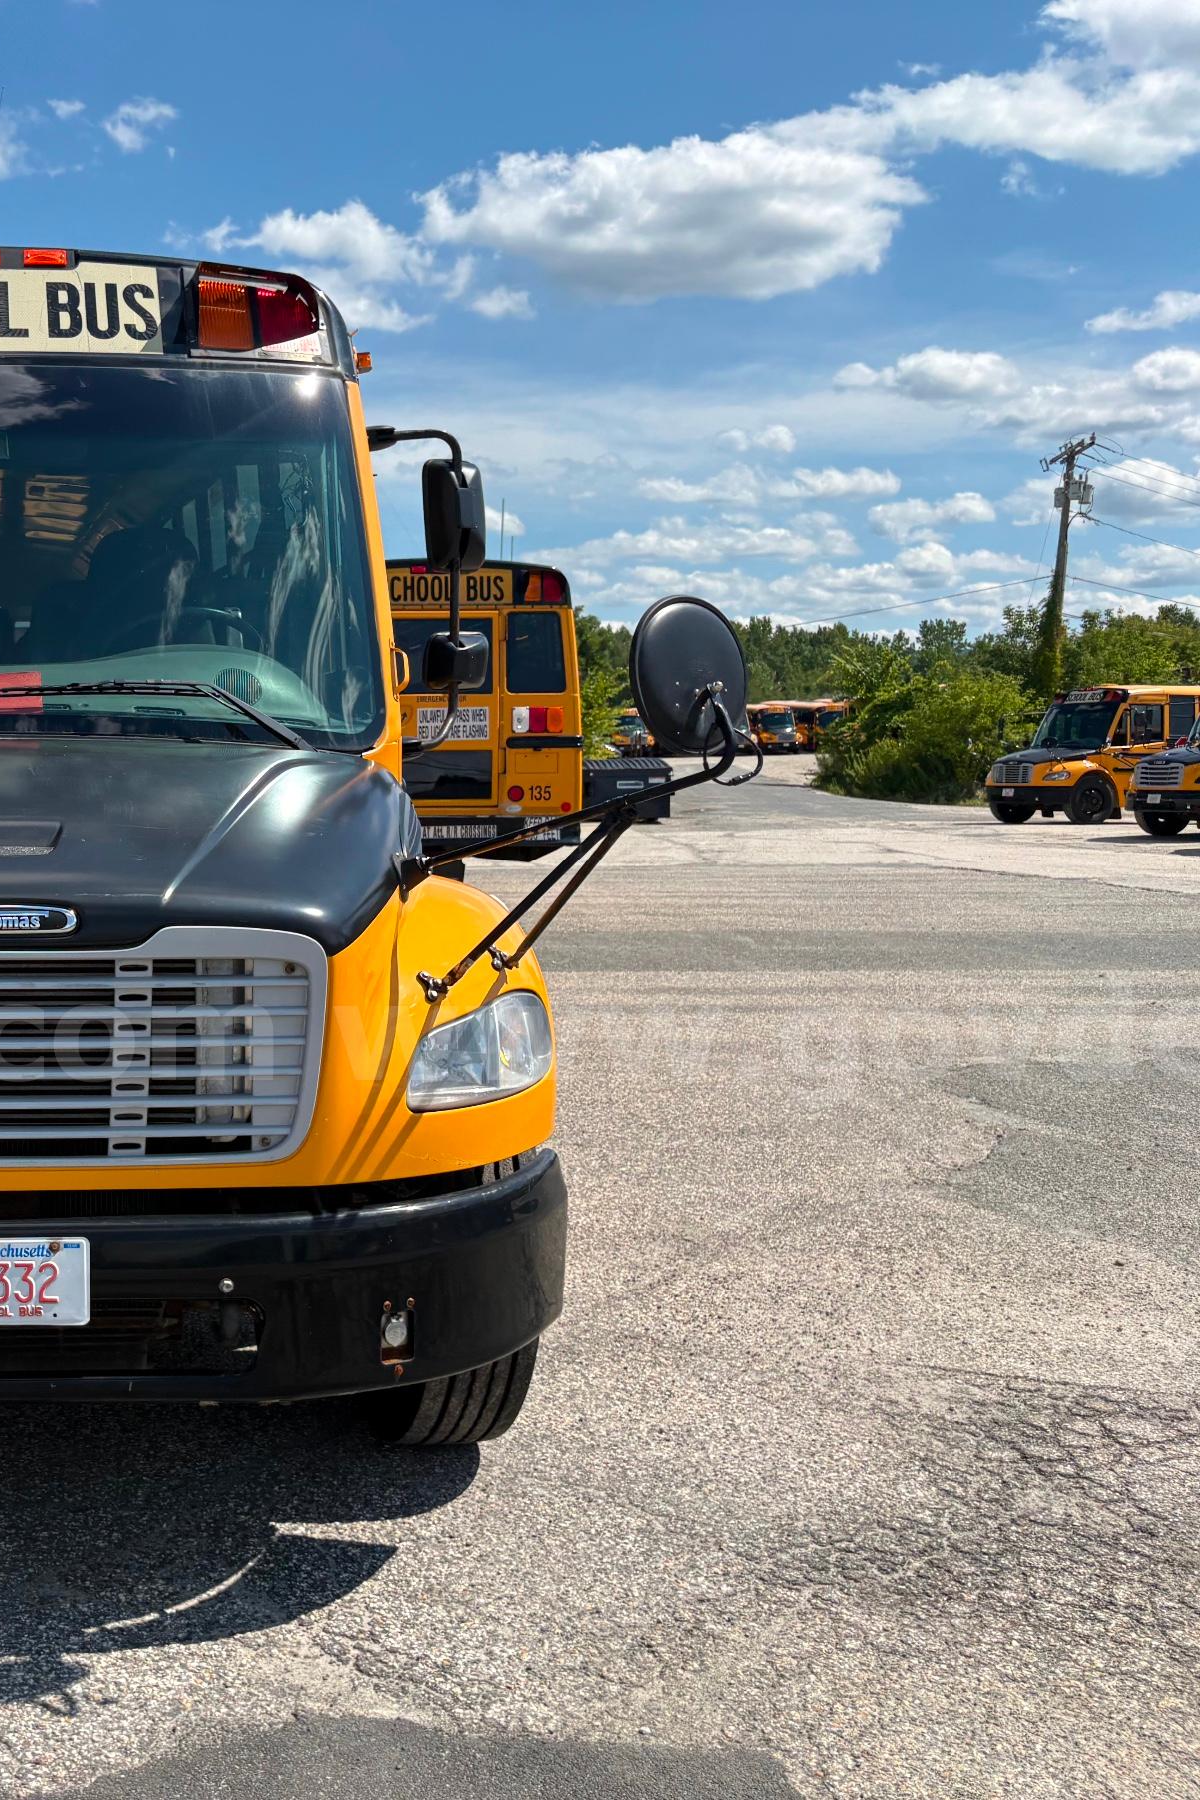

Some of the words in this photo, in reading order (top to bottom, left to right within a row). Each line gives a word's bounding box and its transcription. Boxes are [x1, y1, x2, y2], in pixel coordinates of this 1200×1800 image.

[46, 282, 159, 340] BUS
[466, 575, 504, 601] BUS
[419, 709, 446, 723] UNLAWFU
[471, 708, 487, 722] WHEN
[418, 725, 429, 738] RED
[462, 725, 488, 738] FLASHING
[528, 785, 552, 801] 135
[18, 1305, 44, 1317] BUS
